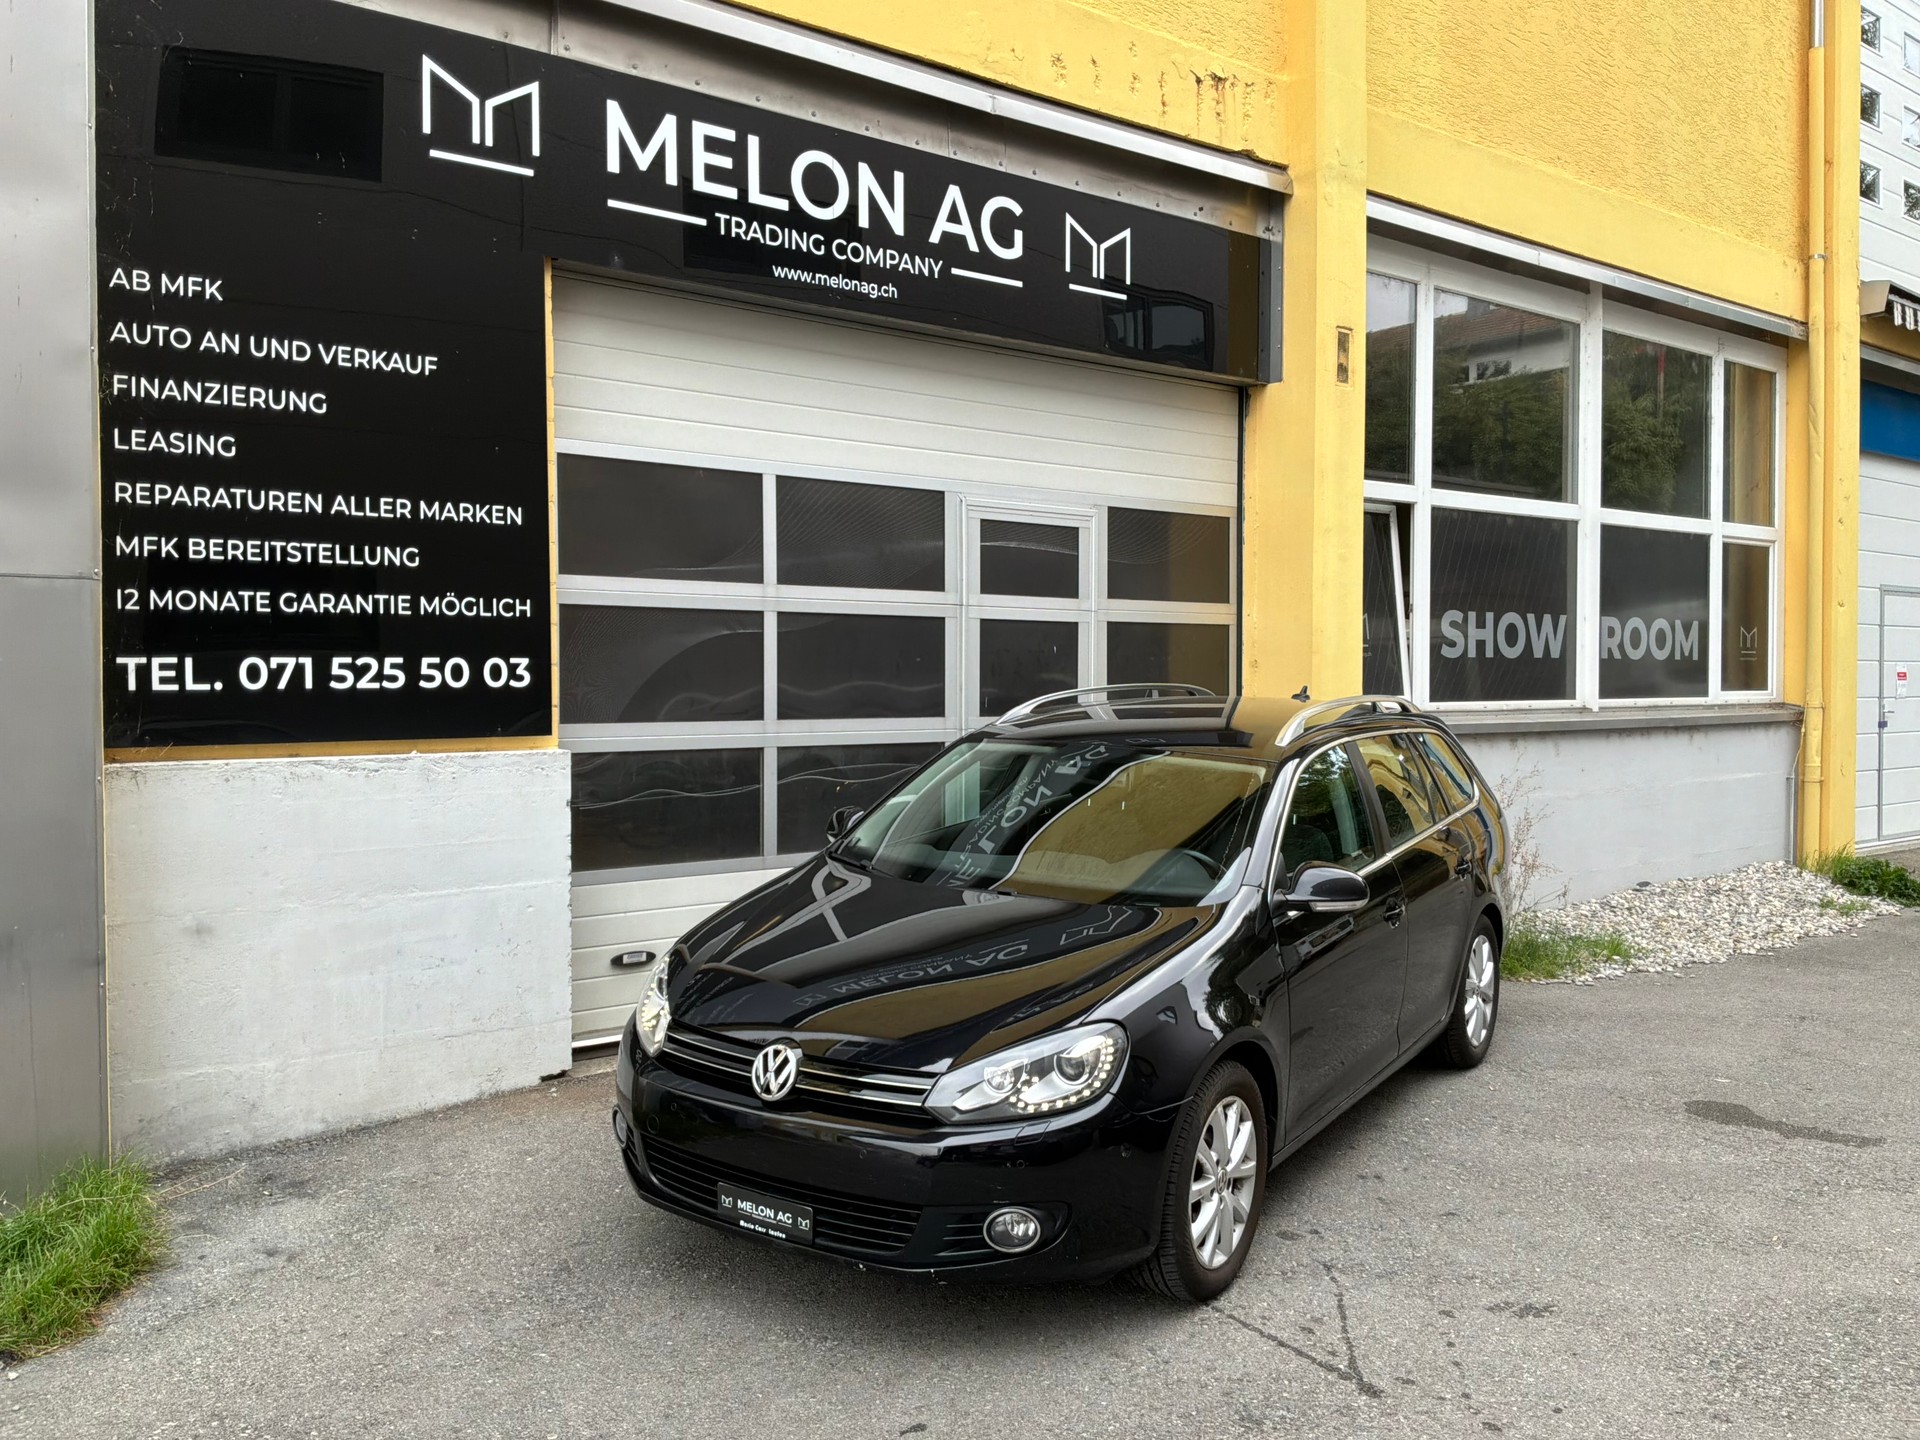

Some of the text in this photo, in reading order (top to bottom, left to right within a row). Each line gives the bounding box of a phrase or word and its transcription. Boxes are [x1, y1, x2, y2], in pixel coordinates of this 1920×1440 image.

[606, 98, 1024, 260] MELON AG
[714, 212, 944, 279] TRADING COMPANY
[108, 267, 224, 302] AB MFK
[772, 264, 899, 299] www.melonag.ch
[109, 321, 438, 376] AUTO AN UND VERKAUF
[112, 374, 327, 415] FINANZIERUNG
[113, 427, 236, 456] LEASING
[114, 481, 522, 526] REPARATUREN ALLER MARKEN
[115, 535, 420, 568] MFK BEREITSTELLUNG
[116, 588, 531, 618] 12 MONATE GARANTIE MÖGLICH
[1440, 609, 1699, 661] SHOW ROOM
[115, 656, 531, 692] TEL. 071 525 50 03
[737, 1199, 774, 1219] MELON
[777, 1211, 792, 1224] AG
